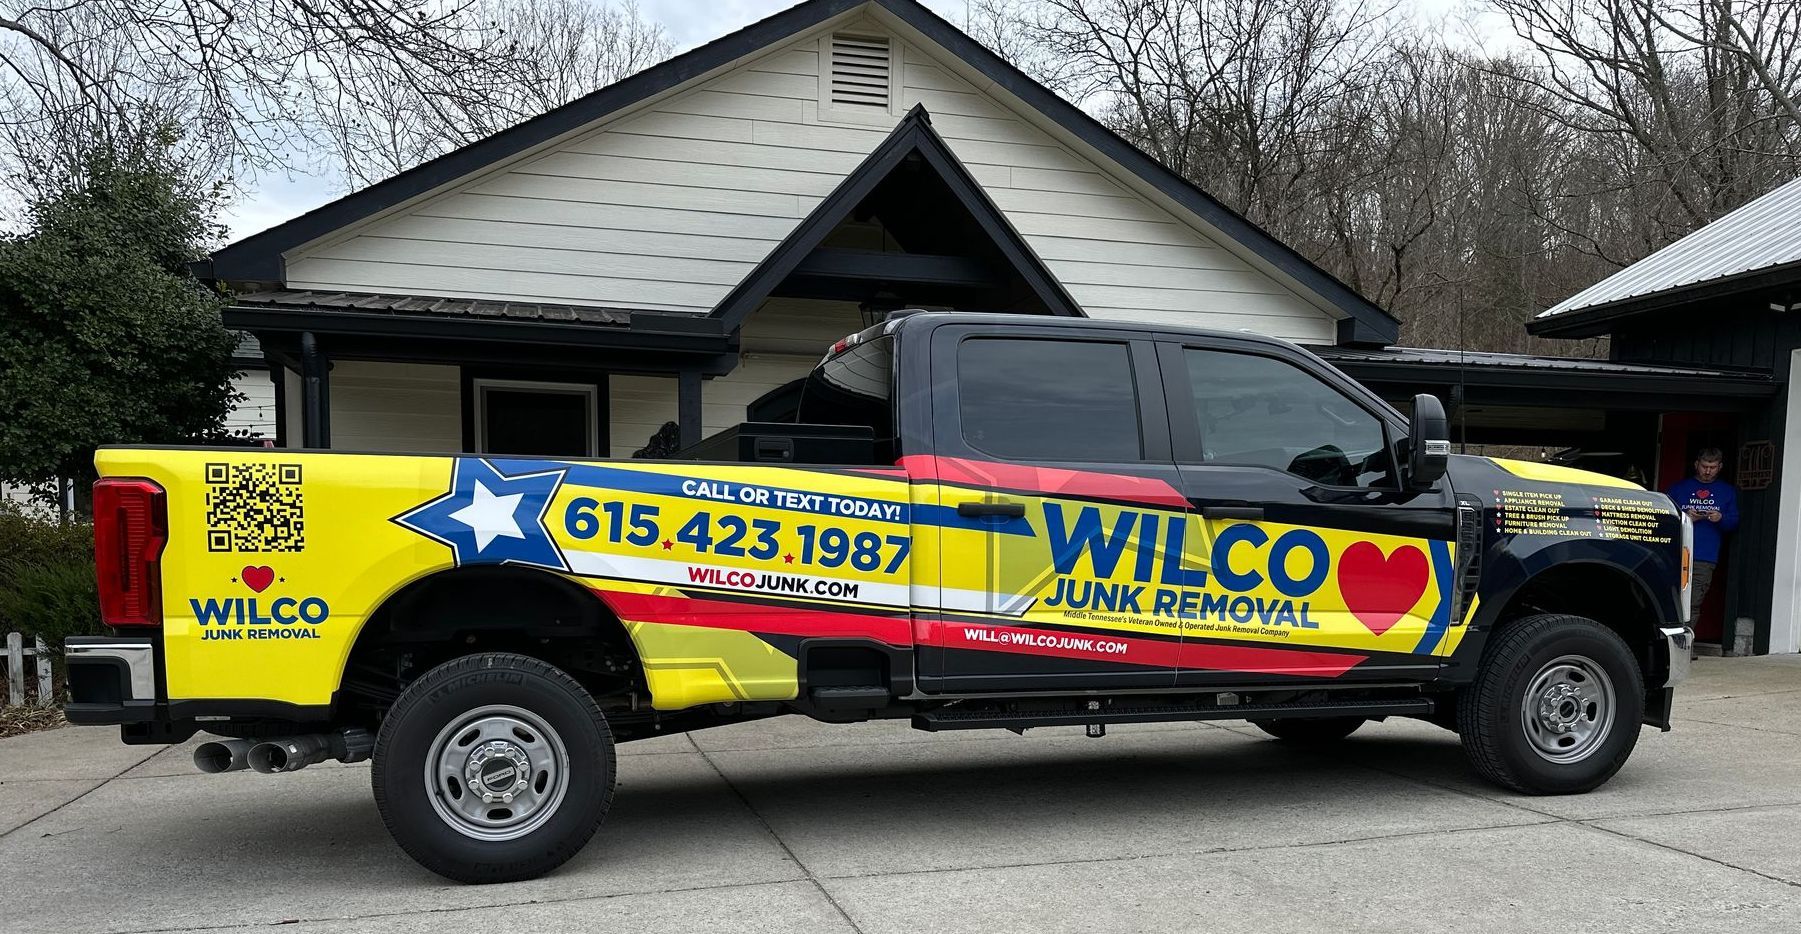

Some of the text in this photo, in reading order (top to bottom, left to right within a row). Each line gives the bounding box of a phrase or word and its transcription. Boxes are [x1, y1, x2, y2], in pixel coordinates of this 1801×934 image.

[681, 479, 901, 520] CALL OR TEXT TODAY!
[1041, 501, 1330, 598] WILCO
[688, 566, 859, 599] WILCOJUNK.COM
[189, 597, 330, 626] WILCO
[1044, 578, 1319, 630] JUNK REMOVAL
[201, 628, 321, 640] JUNK REMOVAL
[1063, 610, 1087, 620] Middle
[1088, 612, 1127, 624] Tennessee's
[1128, 616, 1154, 626] Veteran
[1154, 618, 1177, 628] Owned
[1178, 621, 1184, 629] &
[1184, 622, 1215, 632] Operated
[1232, 626, 1260, 634] Removal
[1260, 628, 1290, 638] Company
[964, 628, 1128, 655] WILL@WILCOJUNK.COM
